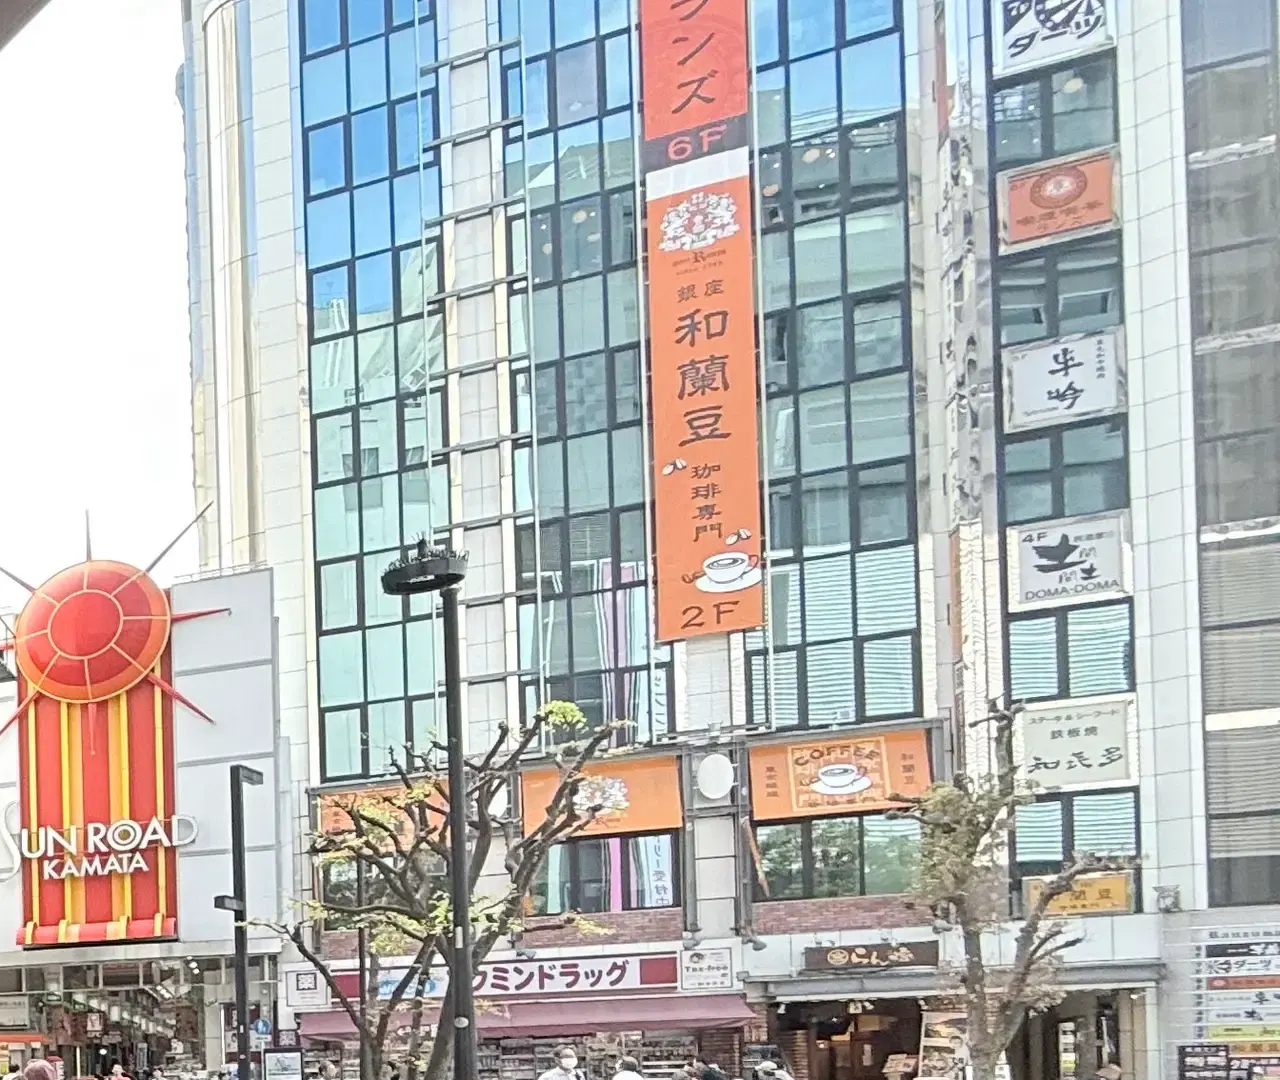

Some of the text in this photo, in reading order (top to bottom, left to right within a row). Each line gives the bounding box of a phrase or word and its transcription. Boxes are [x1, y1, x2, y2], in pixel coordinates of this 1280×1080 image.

[667, 123, 728, 161] 6F
[676, 279, 725, 303] 銀座
[674, 307, 732, 447] 和蘭豆
[691, 463, 723, 542] 珈琲専門
[1022, 531, 1048, 543] 4F
[1024, 579, 1120, 600] DOMA-DOMA
[680, 600, 741, 630] 2F
[794, 745, 880, 766] COFFEE
[0, 800, 199, 883] SUN ROAD
[42, 851, 150, 880] KAMATA
